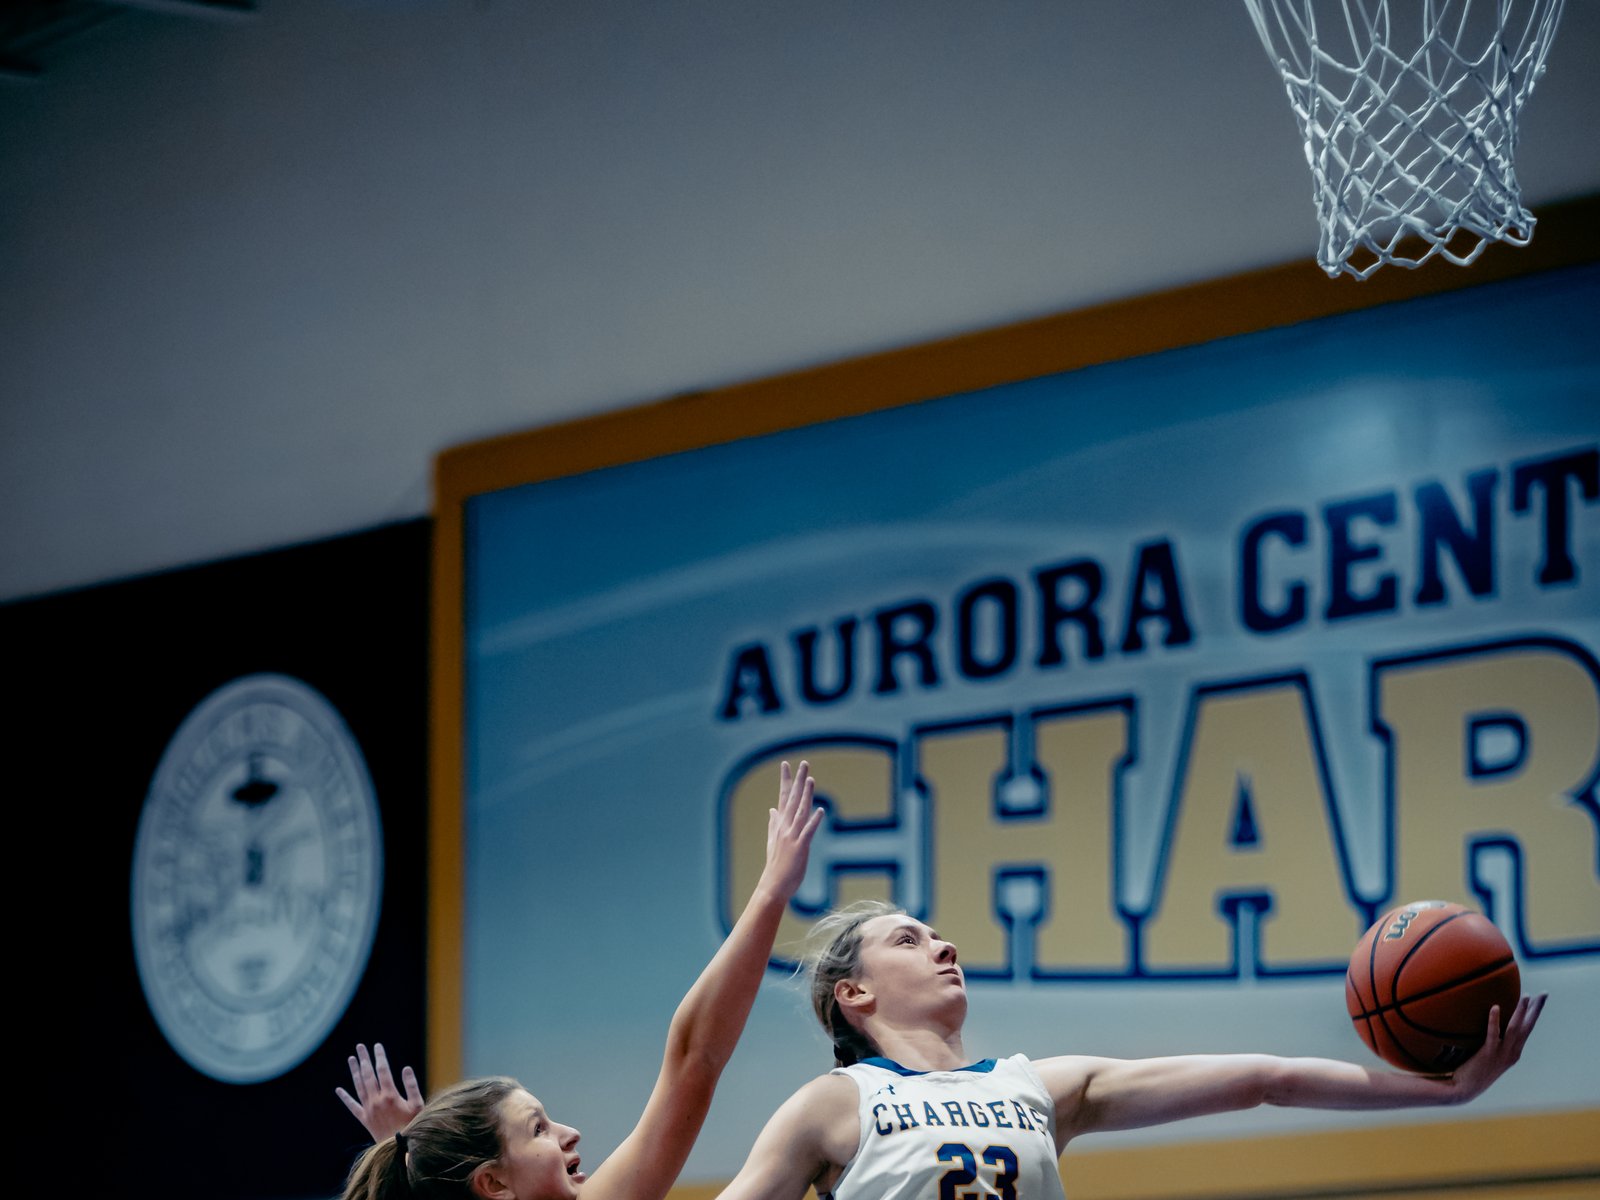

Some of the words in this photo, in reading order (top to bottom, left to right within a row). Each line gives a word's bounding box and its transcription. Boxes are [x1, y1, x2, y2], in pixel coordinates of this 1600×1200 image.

[719, 536, 1194, 721] AURORA
[1239, 444, 1600, 635] CENT
[717, 634, 1600, 981] CHAR
[872, 1099, 1049, 1137] CHARGERS
